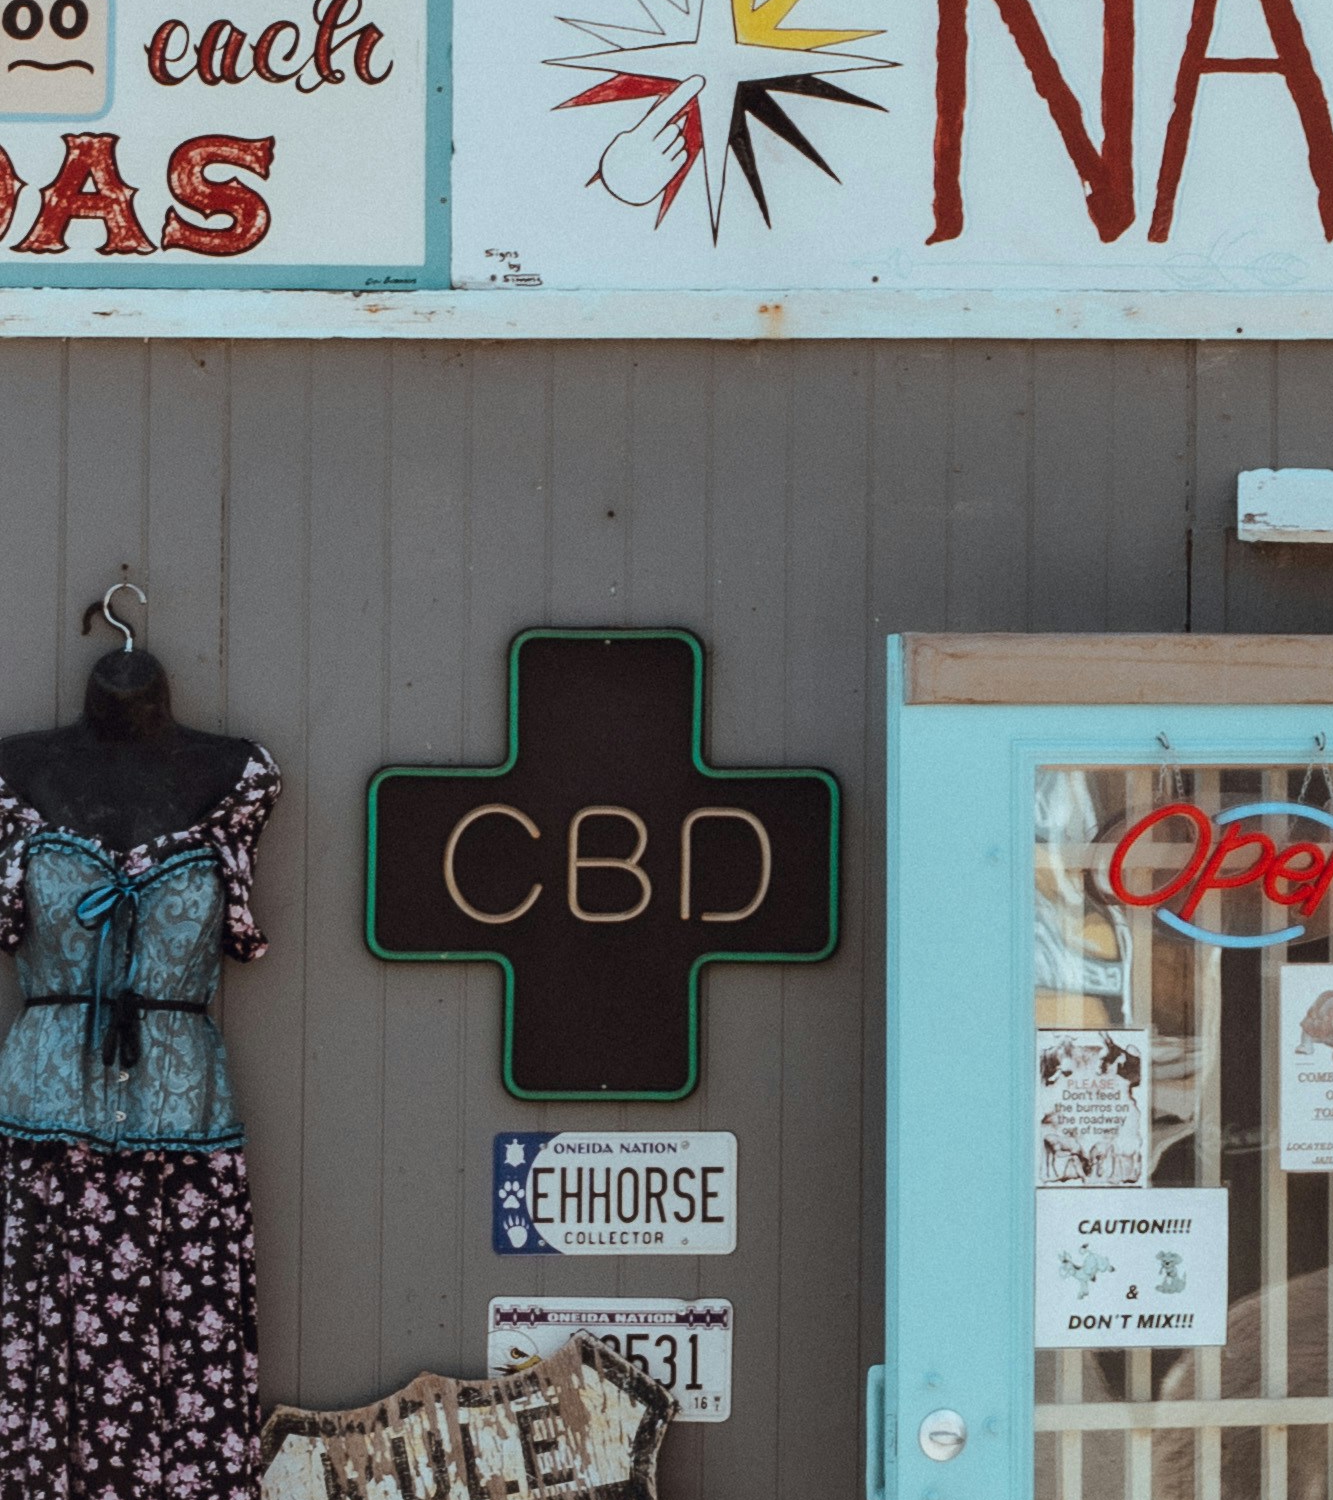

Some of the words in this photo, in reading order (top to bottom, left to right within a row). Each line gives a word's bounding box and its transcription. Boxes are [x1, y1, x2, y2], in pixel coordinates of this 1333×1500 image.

[444, 804, 771, 924] CBD
[1062, 1090, 1092, 1100] Don't
[1096, 1090, 1120, 1100] feed
[1055, 1103, 1072, 1112] the
[1076, 1103, 1112, 1112] burros
[1115, 1104, 1129, 1112] on
[1057, 1115, 1075, 1124] the
[1079, 1114, 1127, 1126] roadway
[1081, 1125, 1090, 1134] of
[553, 1142, 614, 1154] ONEIDA
[620, 1142, 677, 1154] NATION
[532, 1166, 724, 1223] EHHORSE
[1078, 1219, 1192, 1234] CAUTION!!!!
[564, 1231, 664, 1245] COLLECTOR
[1126, 1285, 1138, 1299] &
[547, 1313, 610, 1323] ONEIDA
[614, 1313, 677, 1323] NATION
[1069, 1314, 1132, 1329] DON'T
[1137, 1314, 1194, 1329] MIX!!!
[599, 1333, 702, 1390] 531
